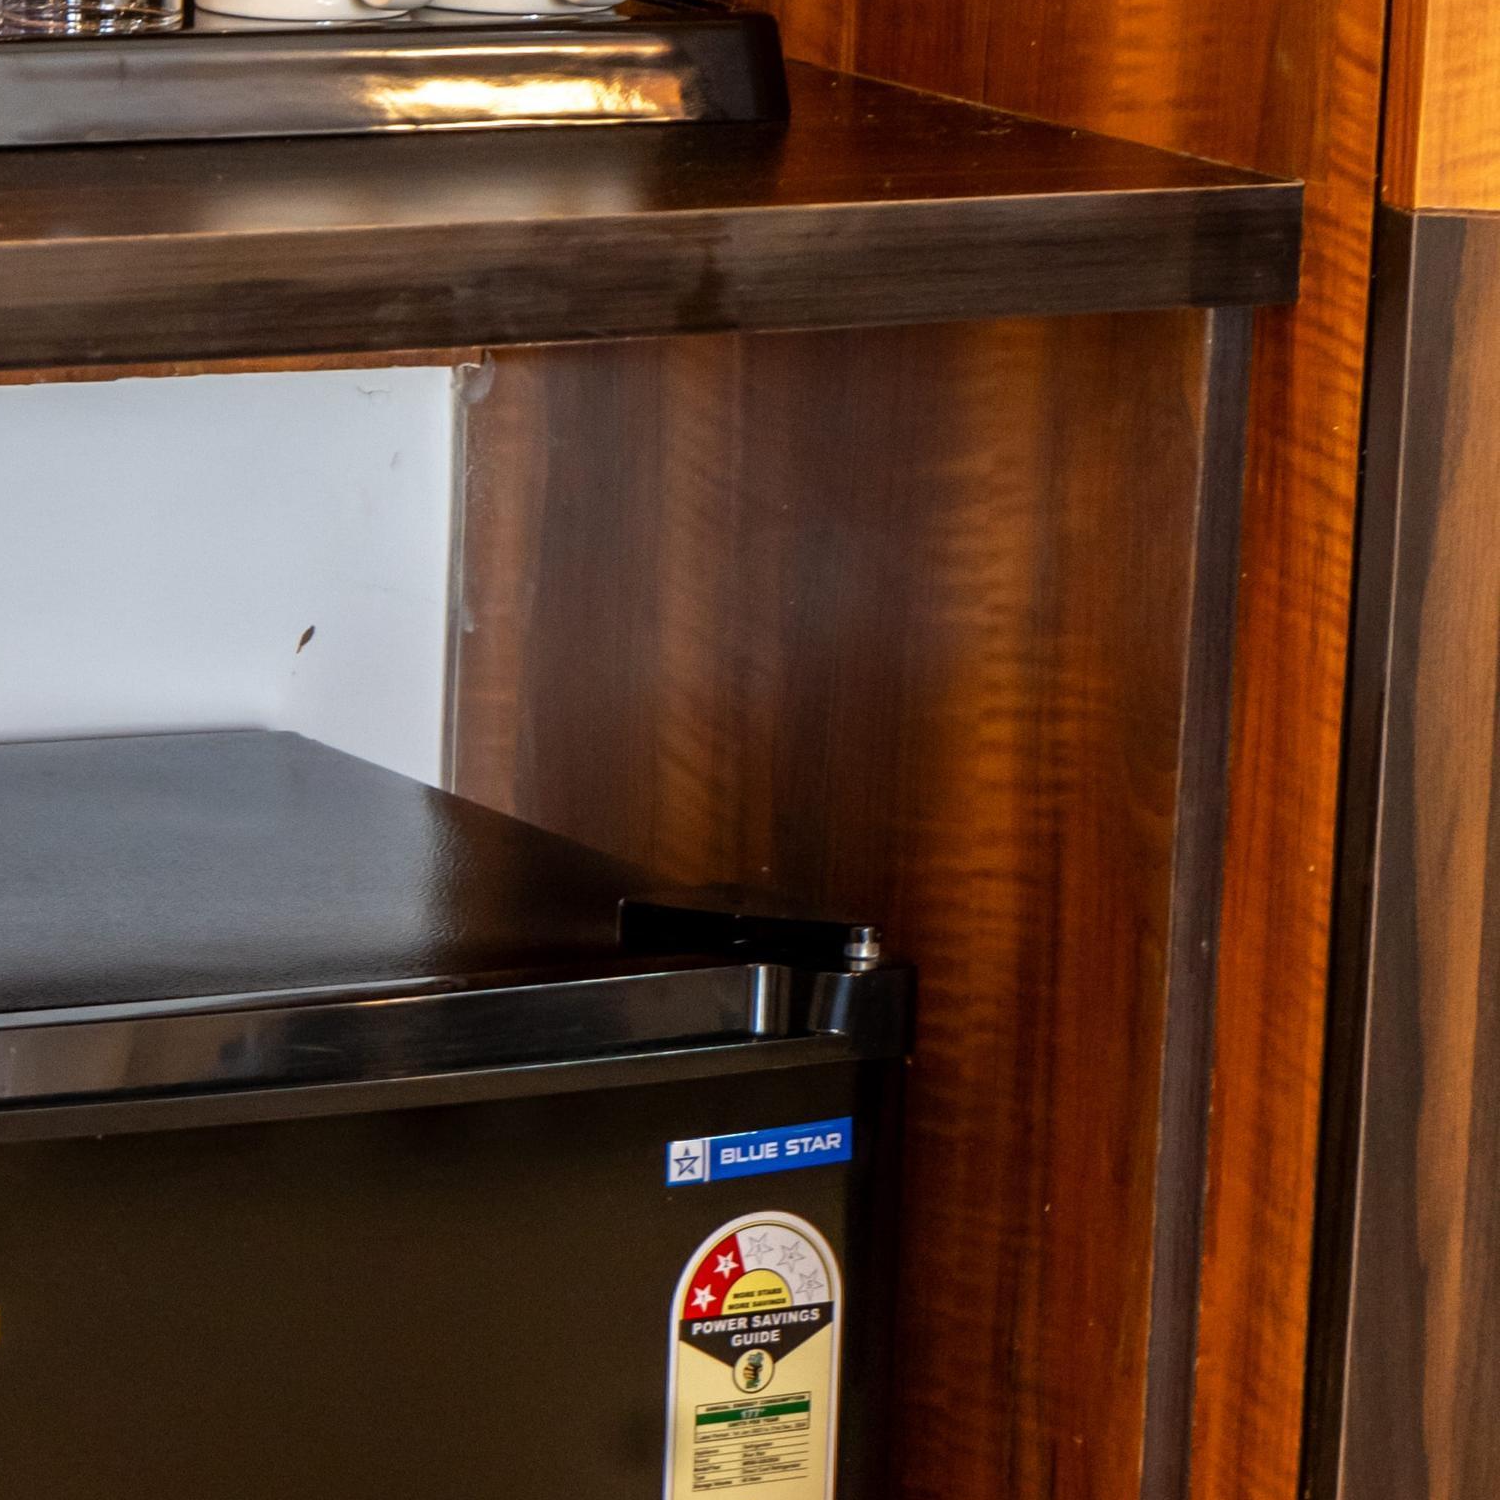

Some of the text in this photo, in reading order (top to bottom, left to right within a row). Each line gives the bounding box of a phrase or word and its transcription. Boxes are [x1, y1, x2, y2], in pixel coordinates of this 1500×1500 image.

[720, 1133, 842, 1165] BLUE STAR
[691, 1308, 820, 1335] POWER SAVINGS
[731, 1329, 781, 1347] GUIDE
